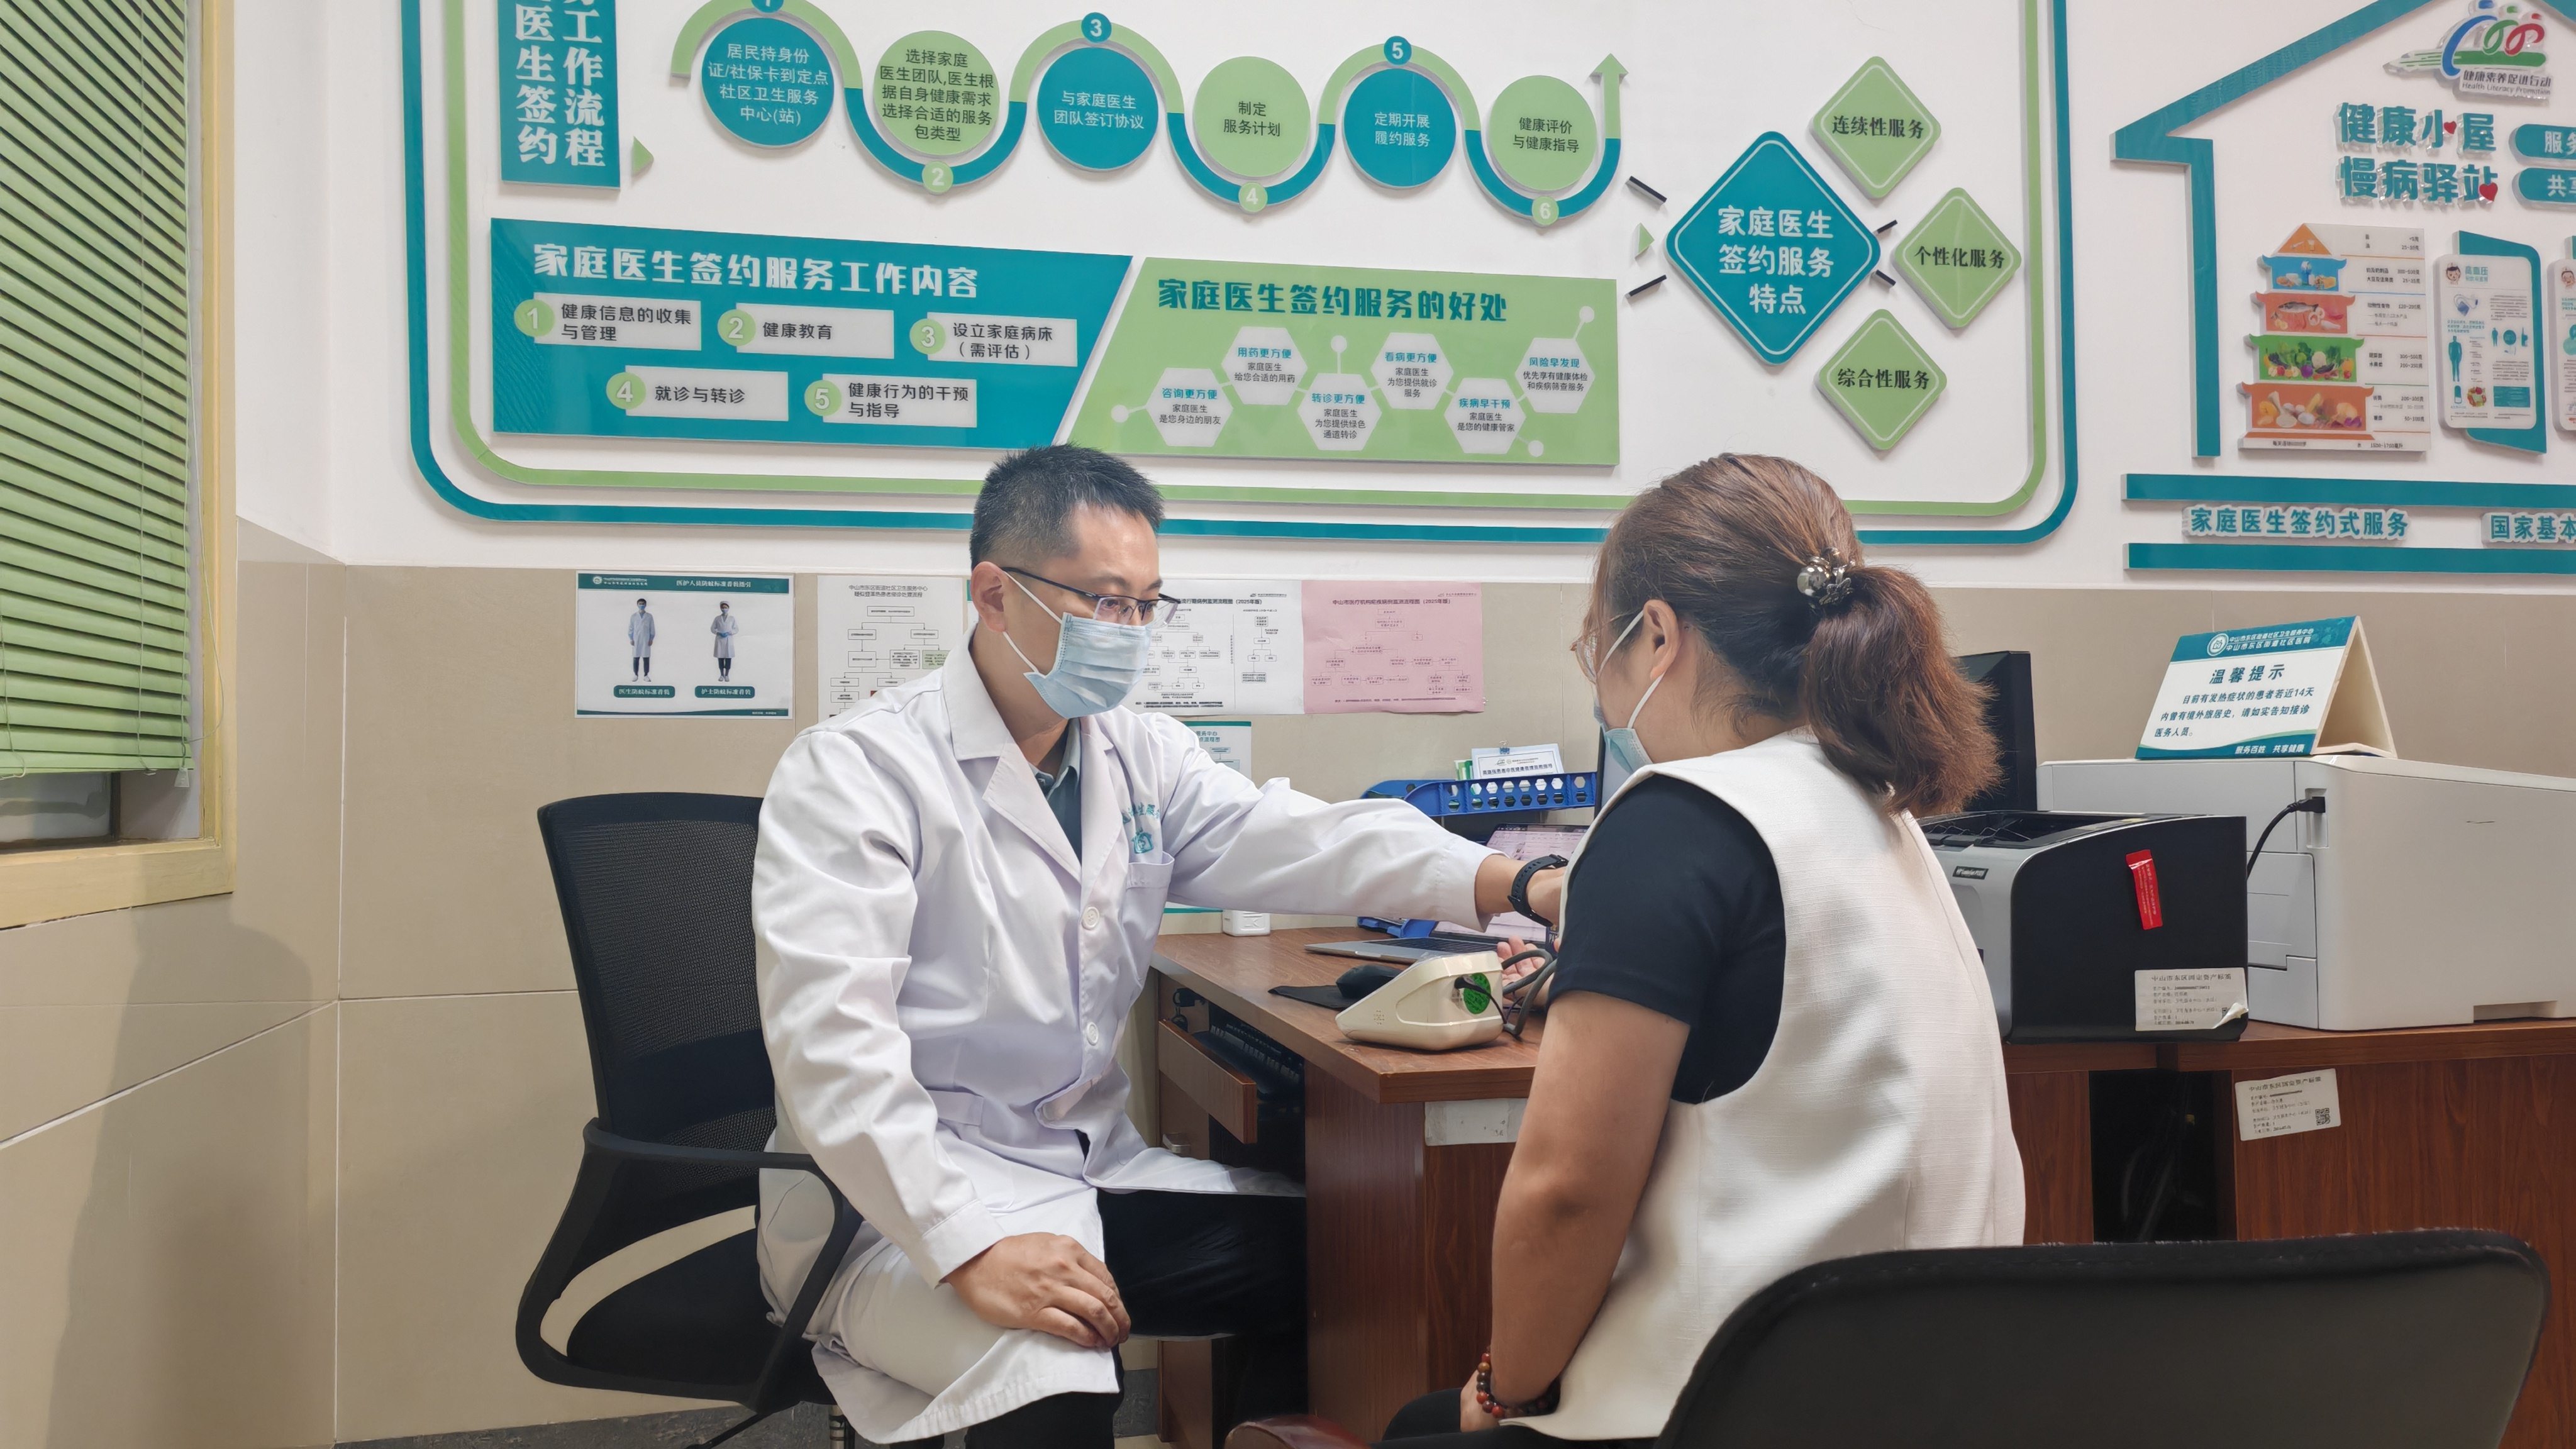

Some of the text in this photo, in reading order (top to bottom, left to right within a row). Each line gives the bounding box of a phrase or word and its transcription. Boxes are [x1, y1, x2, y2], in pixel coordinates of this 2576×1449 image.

[1091, 19, 1102, 36] 3
[728, 43, 809, 64] 居民持身份
[906, 49, 968, 67] 选择家庭
[1392, 42, 1403, 59] 5
[515, 0, 558, 165] 医生签约
[708, 61, 829, 86] 证/社保卡到定点
[880, 65, 994, 89] 医生团队,医生根
[563, 0, 606, 167] 工作流程
[720, 84, 819, 105] 社区卫生服务
[882, 85, 991, 107] 据自身健康需求
[1062, 91, 1136, 109] 与家庭医生
[741, 107, 801, 125] 中心(站)
[882, 103, 992, 125] 选择合适的服务
[1238, 101, 1266, 116] 制定
[1054, 109, 1145, 130] 团队签订协议
[1224, 119, 1280, 137] 服务计划
[1374, 112, 1430, 128] 定期开展
[1519, 116, 1572, 135] 健康评价
[1832, 115, 1924, 140] 连续性服务
[2338, 102, 2496, 152] 健康小屋
[915, 125, 960, 142] 包类型
[1375, 130, 1430, 147] 履约服务
[1513, 135, 1579, 153] 与健康指导
[931, 168, 944, 186] 2
[2340, 156, 2498, 203] 慢病驿站
[1246, 189, 1258, 204] 4
[1540, 203, 1550, 218] 6
[1718, 205, 1834, 239] 家庭医生
[1718, 244, 1834, 277] 签约服务
[1914, 245, 2004, 269] 个性化服务
[534, 243, 978, 297] 家庭医生签约服务工作内容
[1158, 279, 1507, 321] 家庭医生签约服务的好处
[1748, 283, 1806, 314] 特点
[527, 308, 538, 329] 1
[561, 303, 692, 325] 健康信息的收集
[561, 324, 617, 341] 与管理
[728, 318, 744, 339] 2
[763, 321, 833, 340] 健康教育
[921, 326, 935, 348] 3
[953, 322, 1053, 341] 设立家庭病床
[1238, 347, 1292, 359] 用药更方便
[1385, 352, 1437, 364] 看病更方便
[1247, 362, 1282, 372] 家庭医生
[1395, 367, 1429, 377] 家庭医生
[1530, 357, 1580, 369] 风险早发现
[1235, 372, 1295, 384] 给您合适的用药
[1387, 378, 1437, 389] 为您提供就诊
[1523, 371, 1588, 382] 优先享有健康体检
[1838, 368, 1929, 390] 综合性服务
[616, 381, 633, 402] 4
[655, 386, 745, 404] 就诊与转诊
[848, 382, 969, 402] 健康行为的干预
[1162, 388, 1217, 400] 咨询更方便
[1404, 389, 1421, 398] 服务
[1527, 382, 1584, 392] 和疾病筛查服务
[814, 388, 830, 409] 5
[1311, 393, 1365, 404] 转诊更方便
[1459, 398, 1511, 409] 疾病早干预
[848, 402, 899, 418] 与指导
[1172, 404, 1208, 413] 家庭医生
[1323, 409, 1357, 418] 家庭医生
[1469, 412, 1502, 421] 家庭医生
[1159, 414, 1221, 425] 是您身边的朋友
[1315, 419, 1365, 430] 为您提供绿色
[1457, 422, 1515, 433] 是您的健康管家
[1323, 430, 1357, 440] 通道转诊
[2190, 508, 2409, 538] 家庭医生签约式服务
[2490, 515, 2576, 541] 国家基本
[2209, 664, 2285, 684] 温馨提示
[2182, 687, 2314, 704] 目前有发热症状的患者若近14天
[2155, 726, 2193, 737] 医务人员。
[2235, 744, 2306, 754] 服务百姓 共享健康
